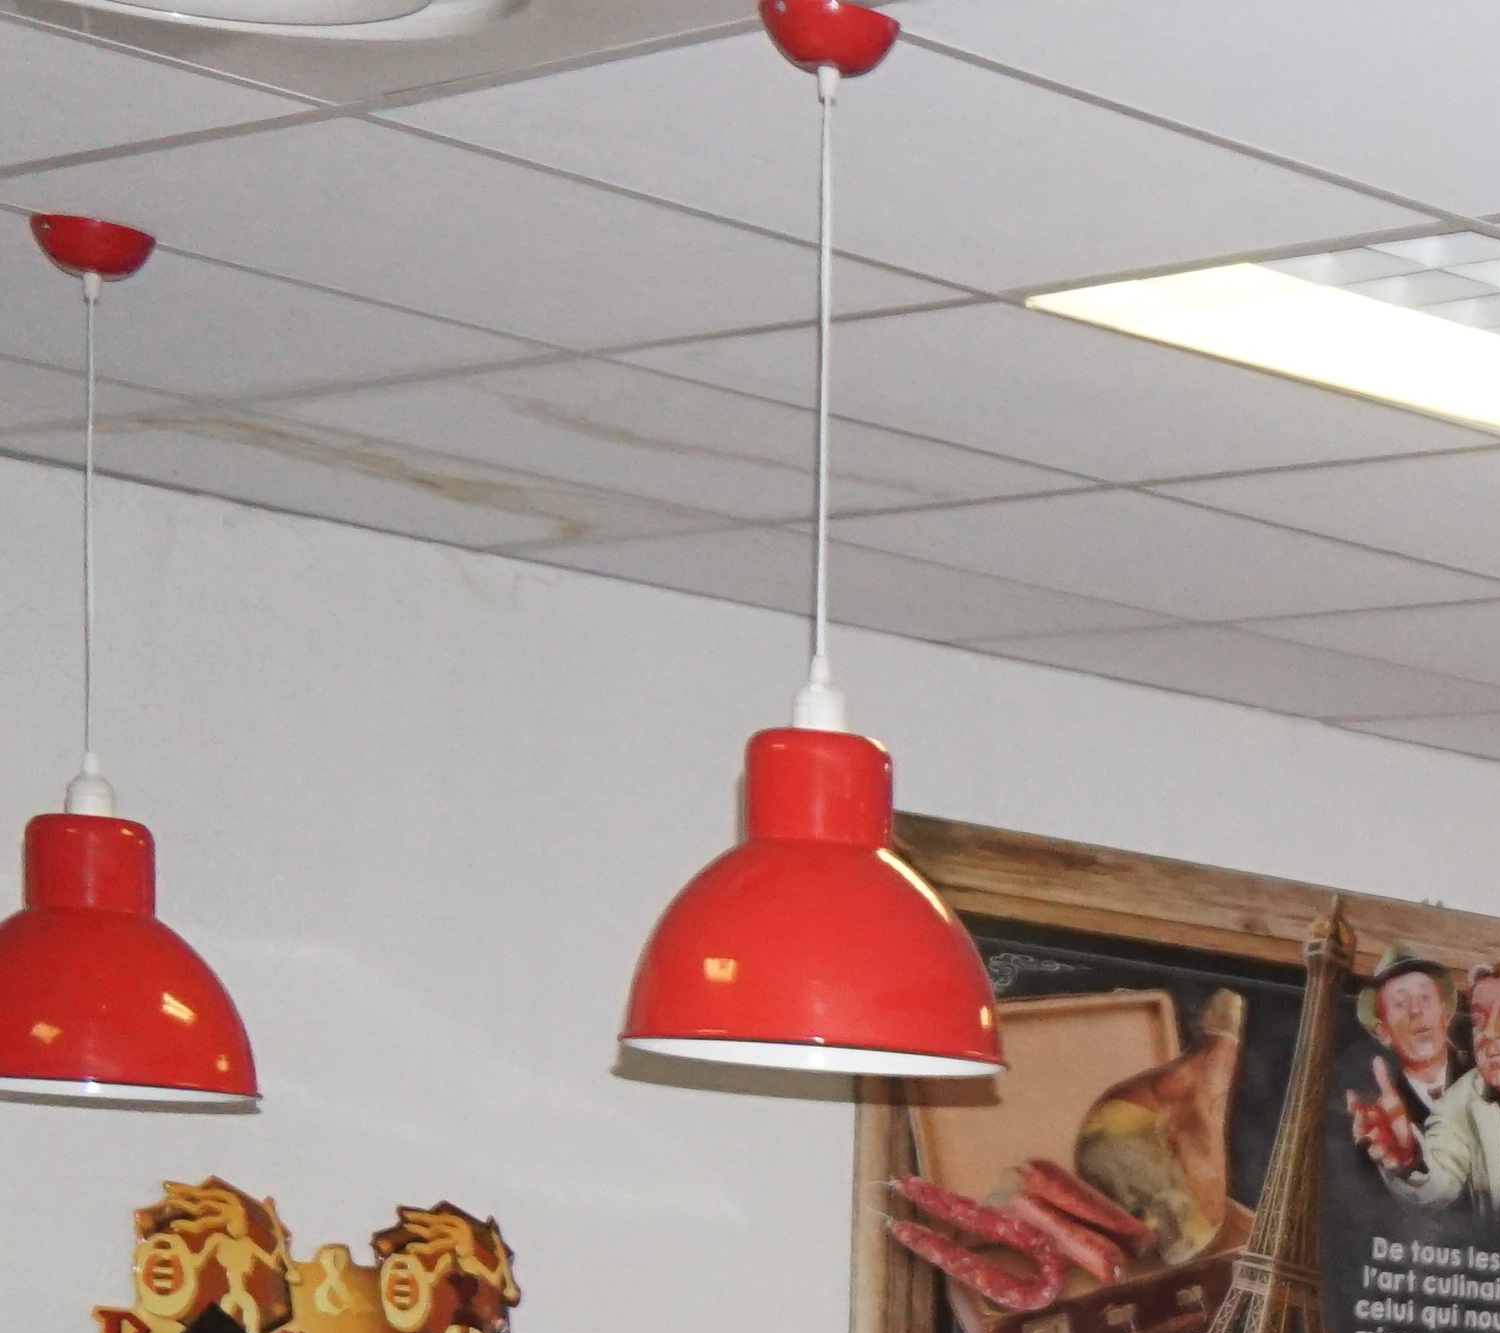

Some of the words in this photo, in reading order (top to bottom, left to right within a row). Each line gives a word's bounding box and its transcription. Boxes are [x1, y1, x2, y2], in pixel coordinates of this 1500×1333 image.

[1371, 1236, 1404, 1262] De
[1411, 1239, 1462, 1267] tous
[1468, 1246, 1500, 1271] les
[1362, 1265, 1417, 1292] l'art
[1354, 1298, 1415, 1324] celui
[1421, 1303, 1459, 1329] qui
